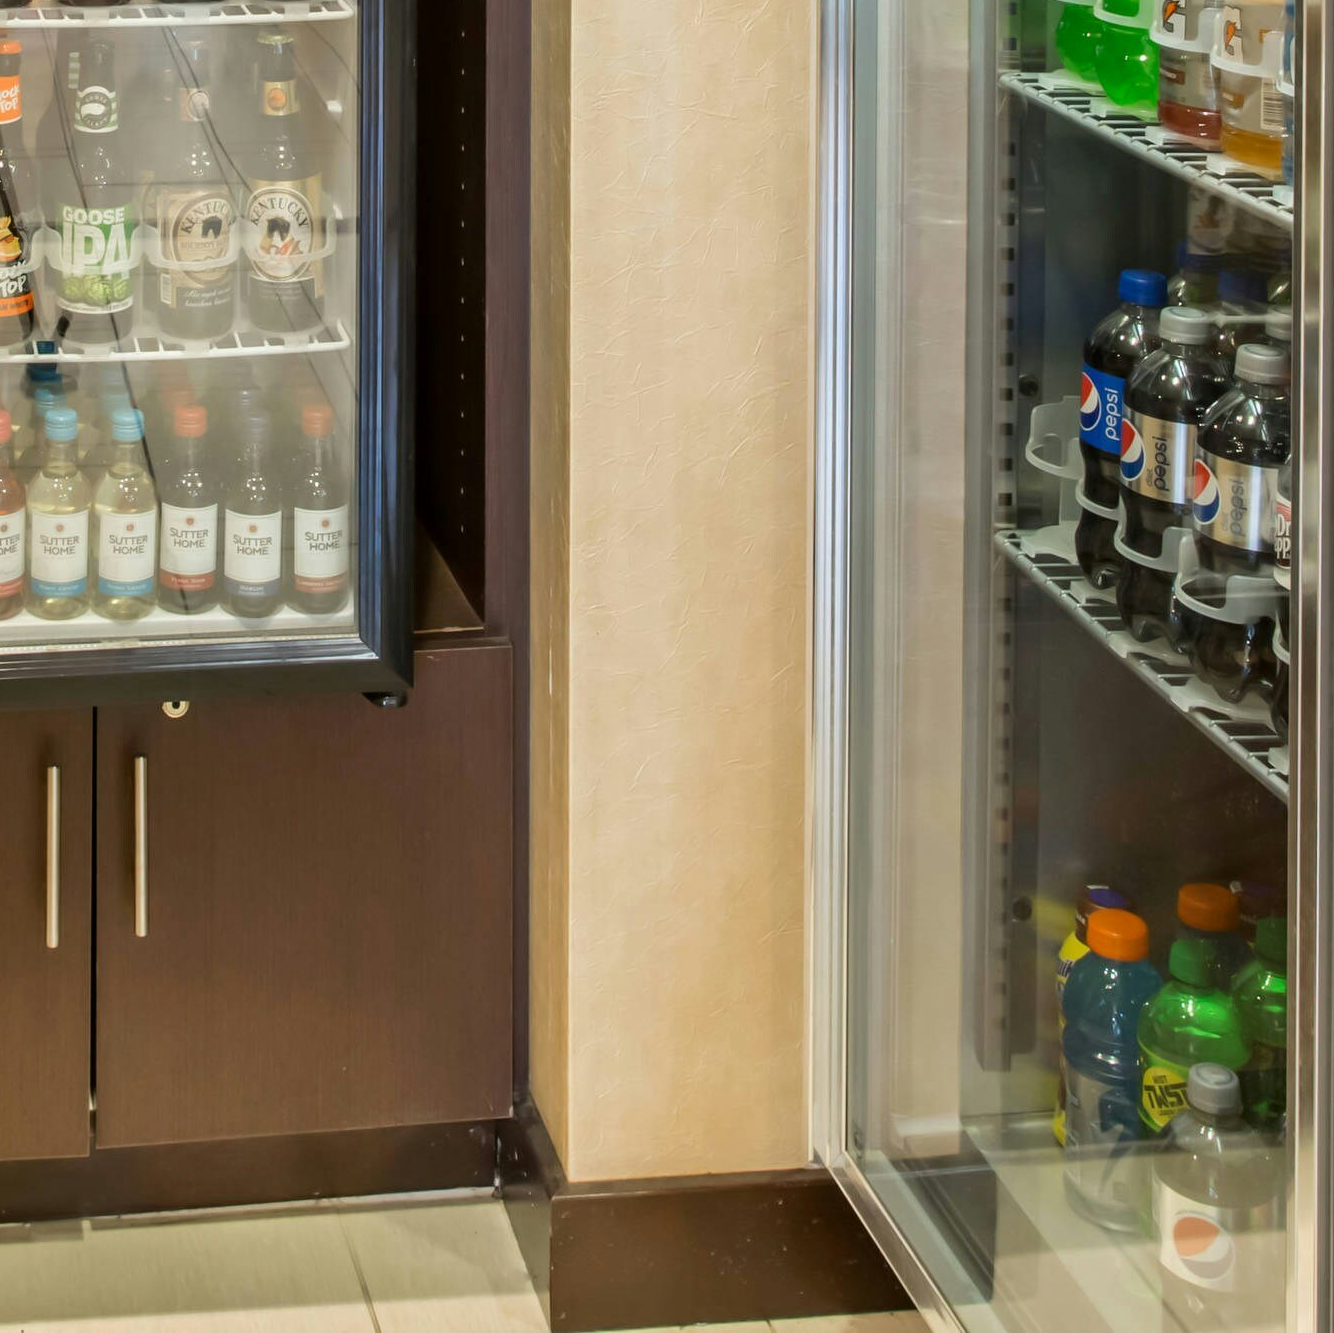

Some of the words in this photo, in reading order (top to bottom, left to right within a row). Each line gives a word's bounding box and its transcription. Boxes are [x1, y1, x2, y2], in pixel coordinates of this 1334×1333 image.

[63, 206, 126, 224] GOOSE
[63, 222, 131, 279] IPA
[1105, 386, 1120, 442] pepsi
[1152, 434, 1170, 493] pepsi
[1146, 466, 1154, 487] diet
[1229, 476, 1248, 538] pepsi
[170, 527, 208, 538] SUTTER
[305, 530, 342, 542] SUTTER
[40, 534, 79, 546] SUTTER
[109, 534, 148, 545] SUTTER
[174, 538, 205, 548] HOME
[233, 534, 273, 546] SUTTER
[44, 545, 76, 555] HOME
[113, 544, 145, 555] HOME
[236, 545, 269, 555] HOME
[309, 541, 340, 551] HOME
